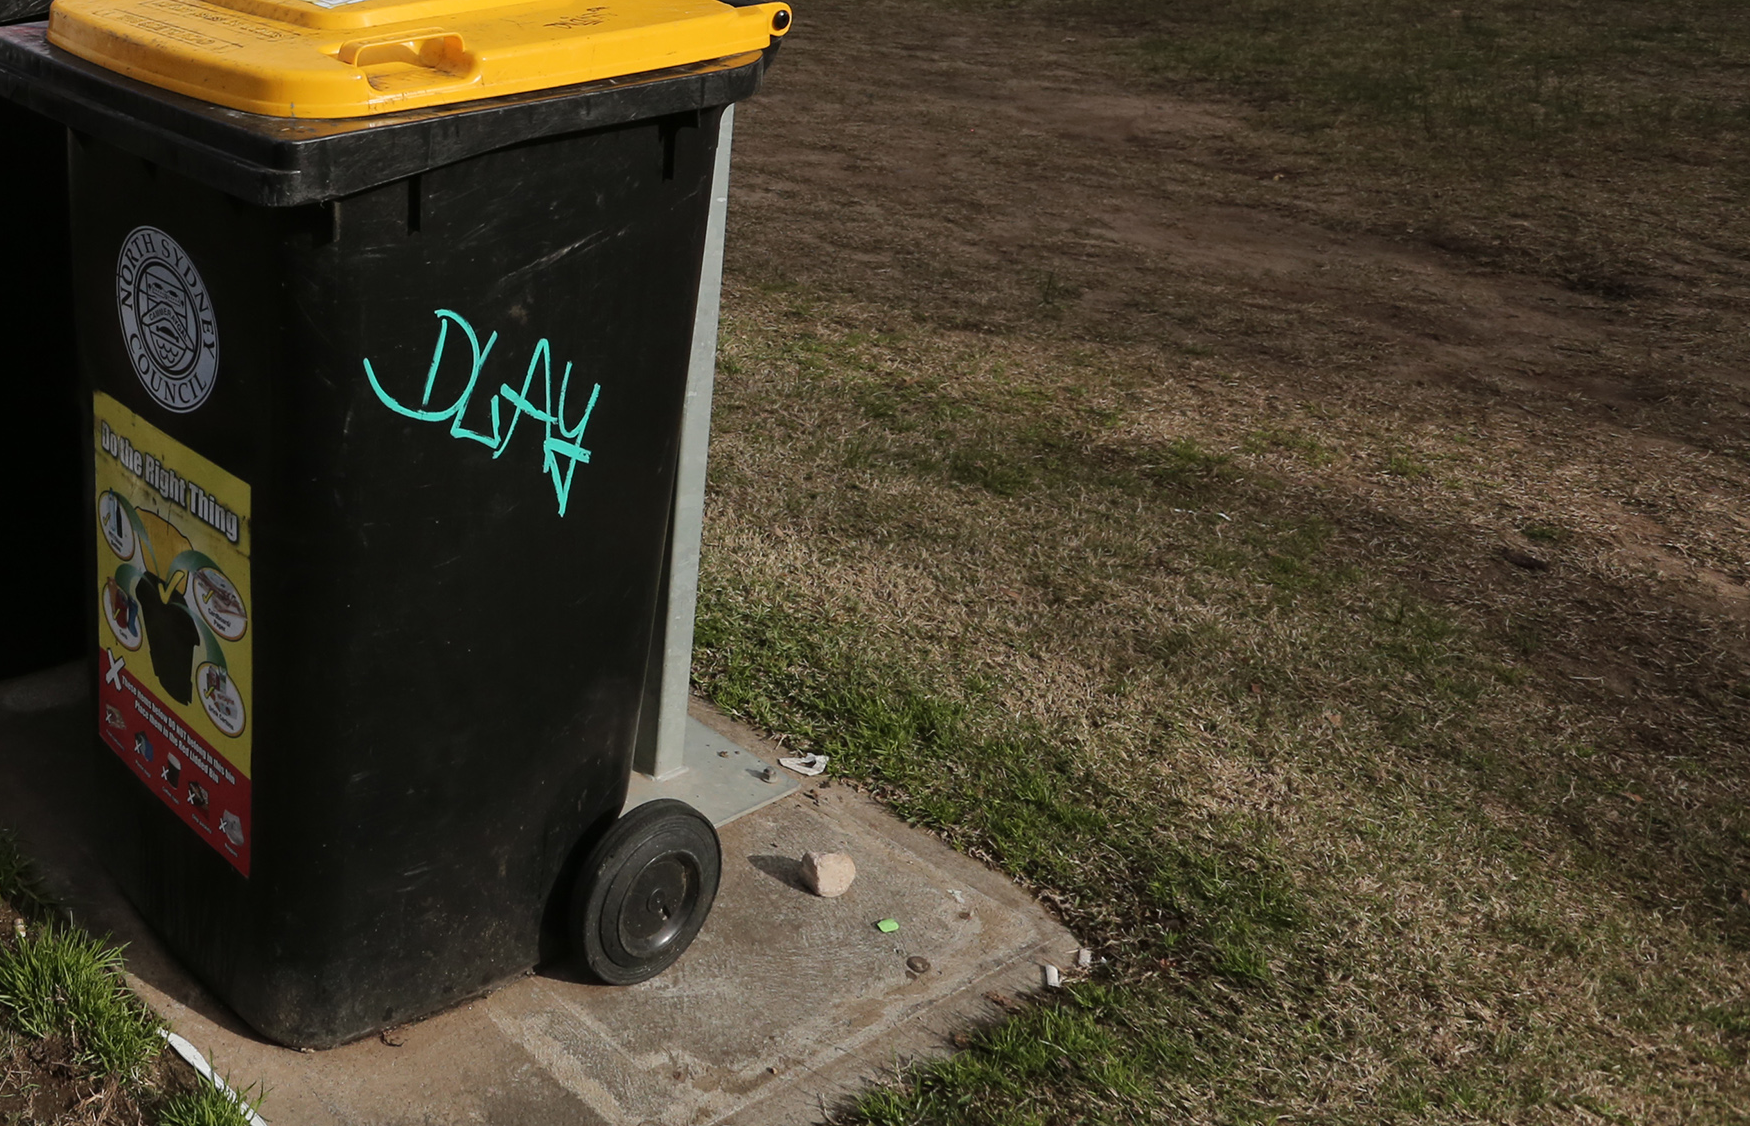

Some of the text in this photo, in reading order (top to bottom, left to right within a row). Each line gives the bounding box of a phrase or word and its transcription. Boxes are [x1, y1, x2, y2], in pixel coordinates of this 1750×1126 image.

[119, 233, 215, 359] NORTH SYDNEY
[129, 333, 208, 405] COUNCIL
[102, 420, 238, 543] Do the Right Thing
[122, 674, 136, 696] These
[152, 701, 167, 724] below
[168, 716, 175, 731] DO
[176, 723, 186, 741] NOT
[187, 733, 206, 760] belong
[207, 751, 212, 765] in
[214, 757, 224, 776] this
[134, 698, 218, 785] Place them in the Red Lidded Bin
